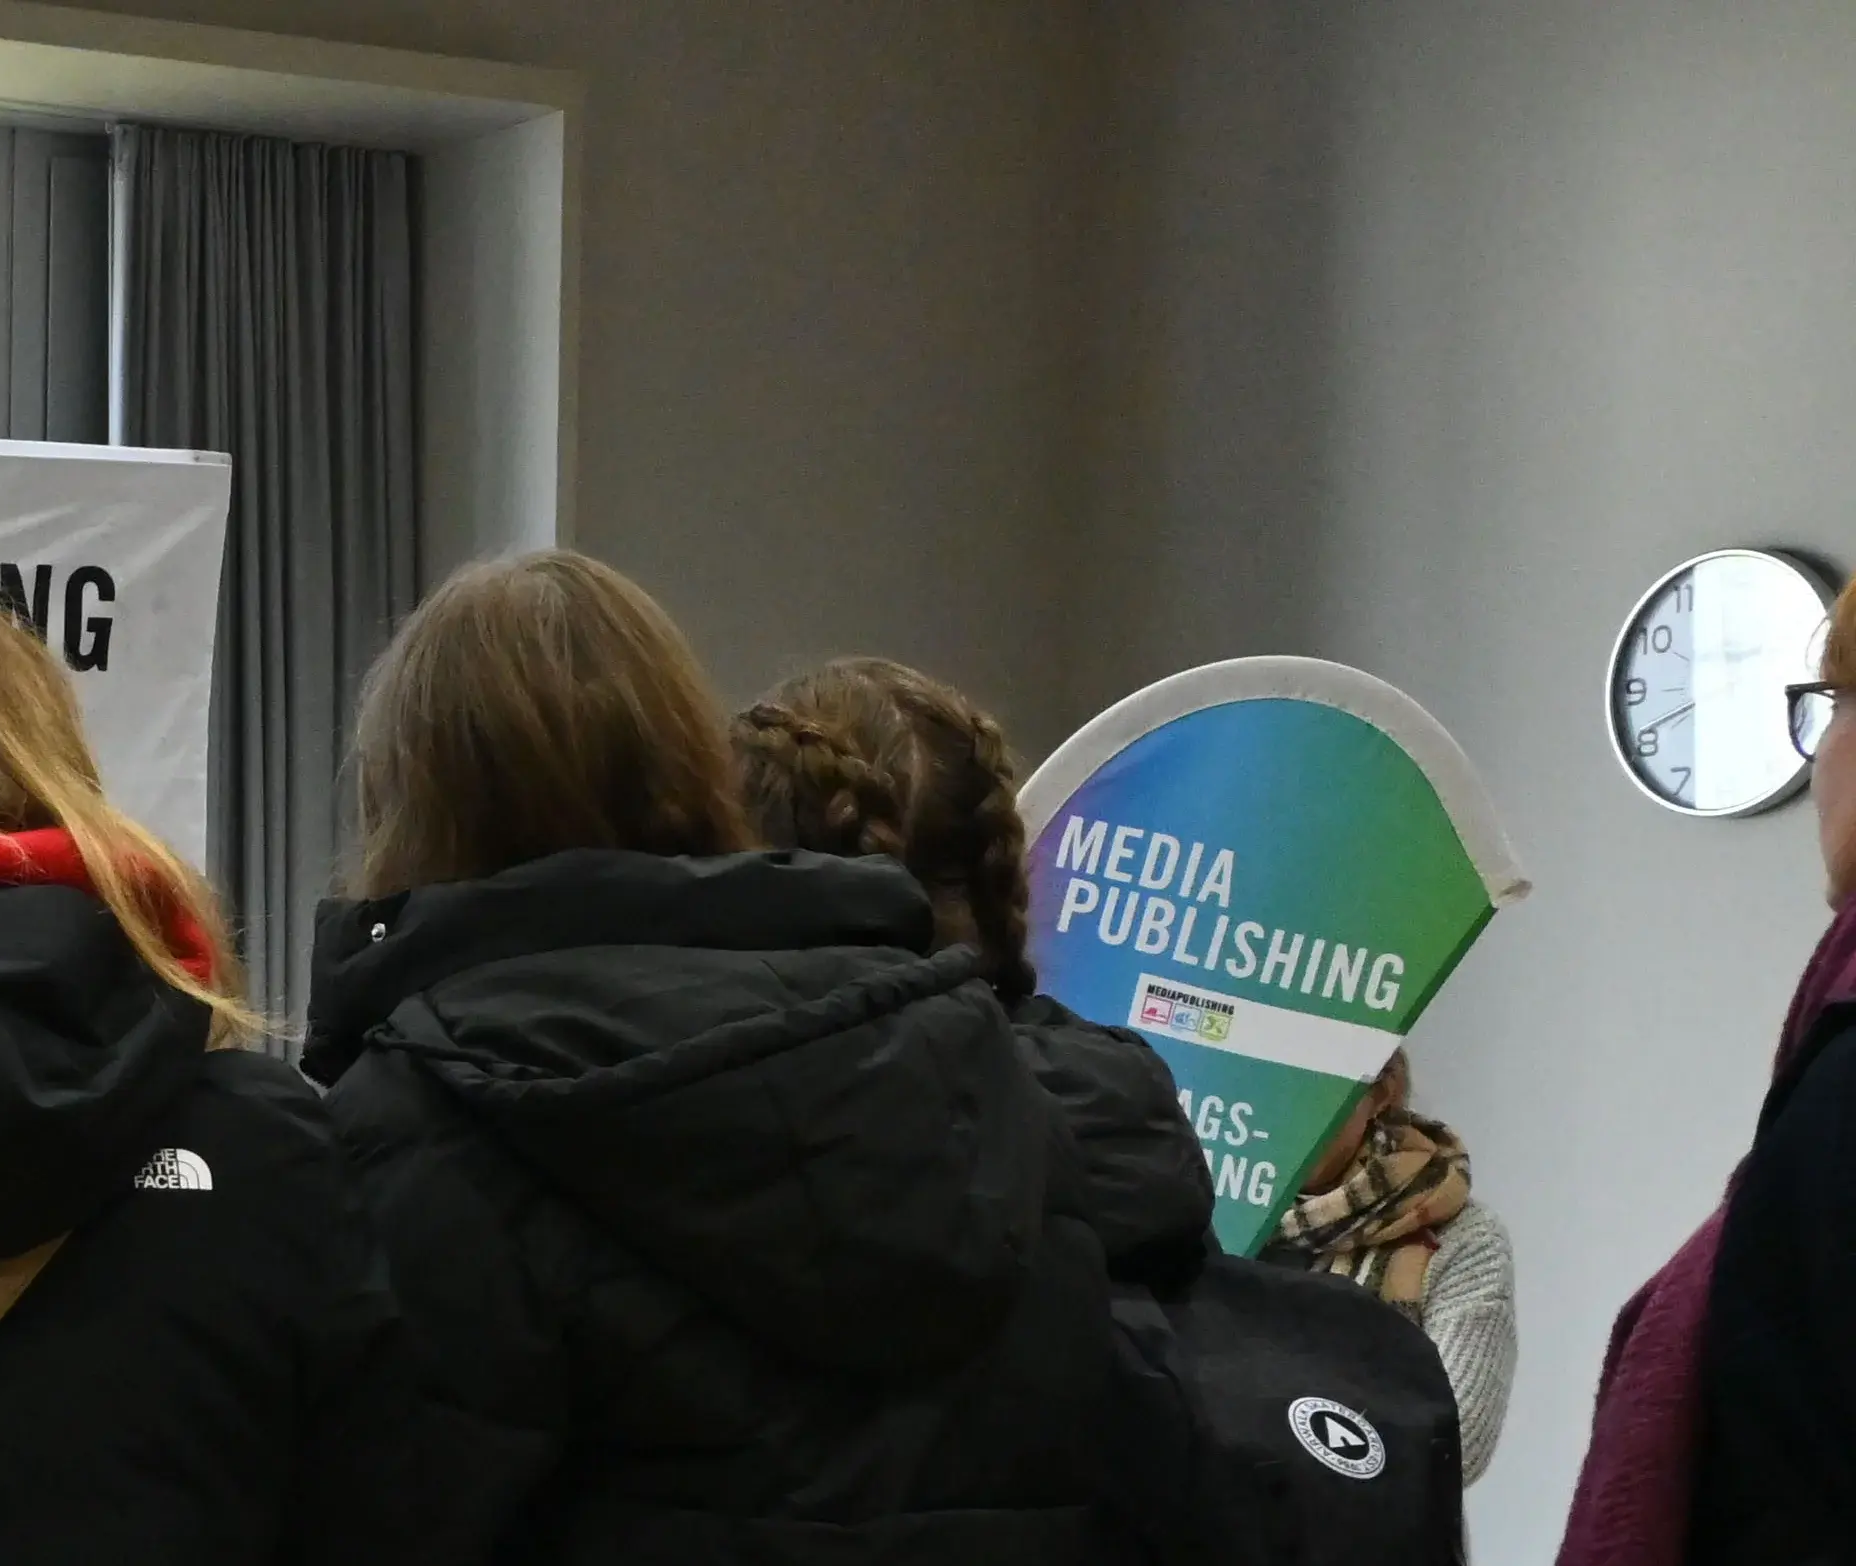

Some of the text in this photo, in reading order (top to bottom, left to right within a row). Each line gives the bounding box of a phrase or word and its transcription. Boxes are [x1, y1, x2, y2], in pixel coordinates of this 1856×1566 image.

[1639, 625, 1672, 655] 10
[1626, 678, 1647, 706] 9
[1638, 728, 1658, 757] 8
[1670, 767, 1691, 796] 7
[1056, 815, 1236, 908] MEDIA
[1057, 878, 1404, 1012] PUBLISHING
[1146, 984, 1236, 1016] MEDIAPUBLISHING
[134, 1174, 180, 1189] FACE
